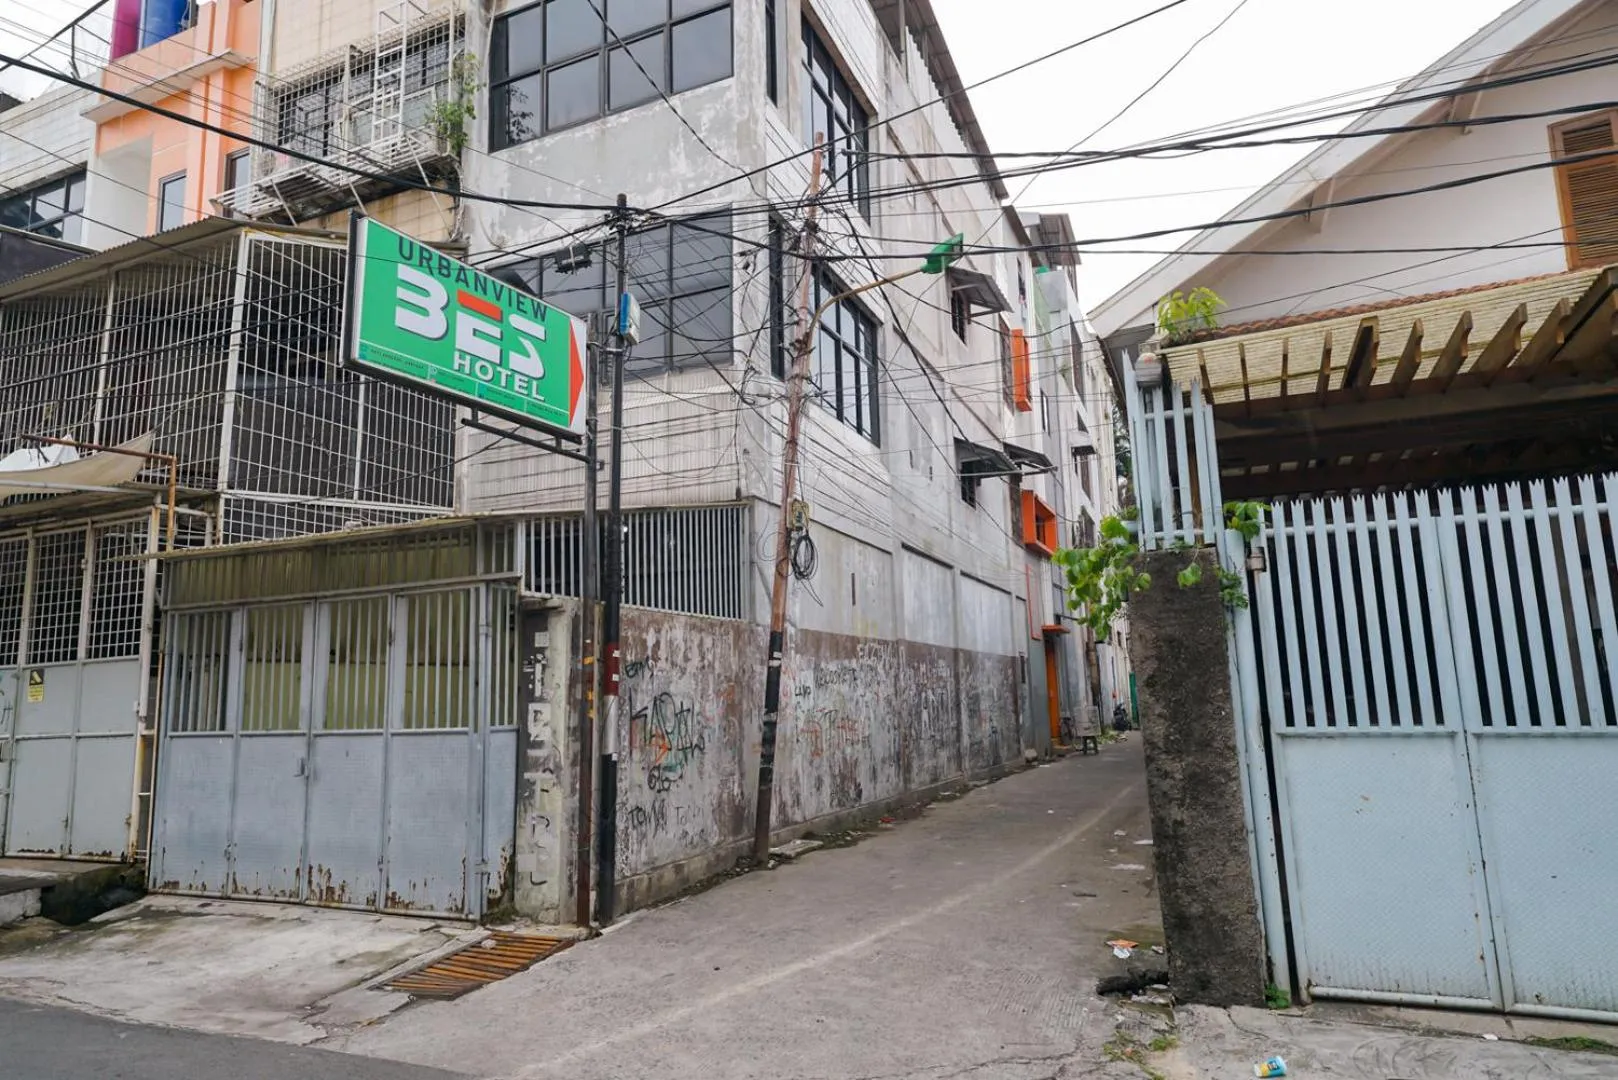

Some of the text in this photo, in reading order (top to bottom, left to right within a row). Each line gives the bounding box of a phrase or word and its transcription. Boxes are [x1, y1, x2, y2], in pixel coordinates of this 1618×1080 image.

[394, 263, 547, 380] BES
[398, 237, 548, 322] URBANVIEW
[453, 350, 546, 401] HOTEL
